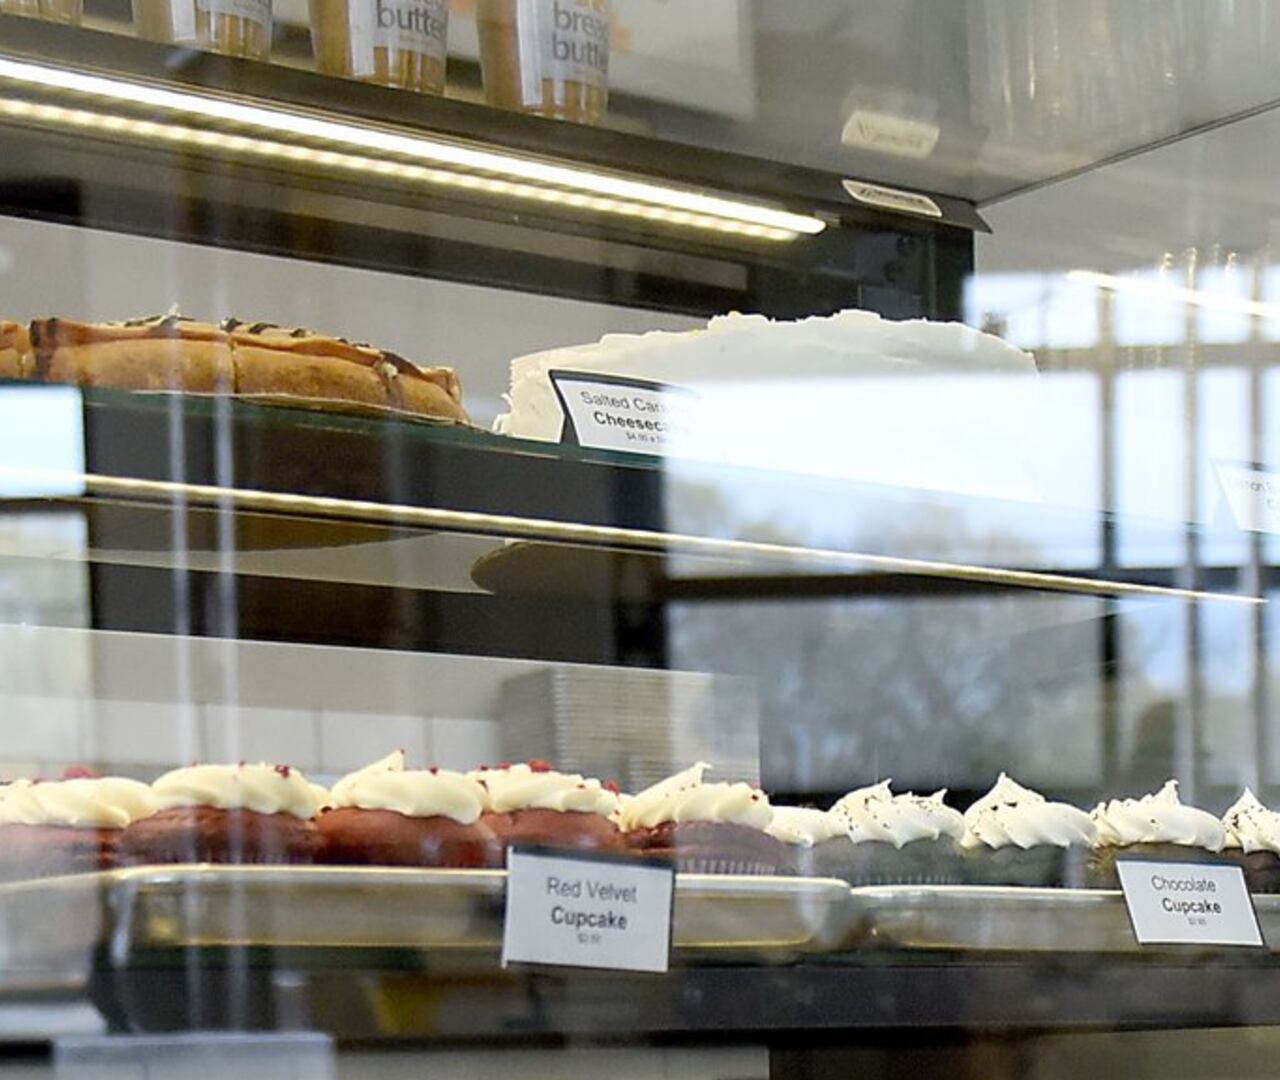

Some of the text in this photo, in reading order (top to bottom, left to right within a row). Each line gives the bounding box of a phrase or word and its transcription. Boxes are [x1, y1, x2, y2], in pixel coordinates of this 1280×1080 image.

[580, 391, 630, 409] Salted
[546, 876, 637, 903] Red Velvet
[1151, 874, 1217, 893] Chocolate
[1162, 897, 1222, 915] Cupcake
[550, 906, 628, 930] Cupcake
